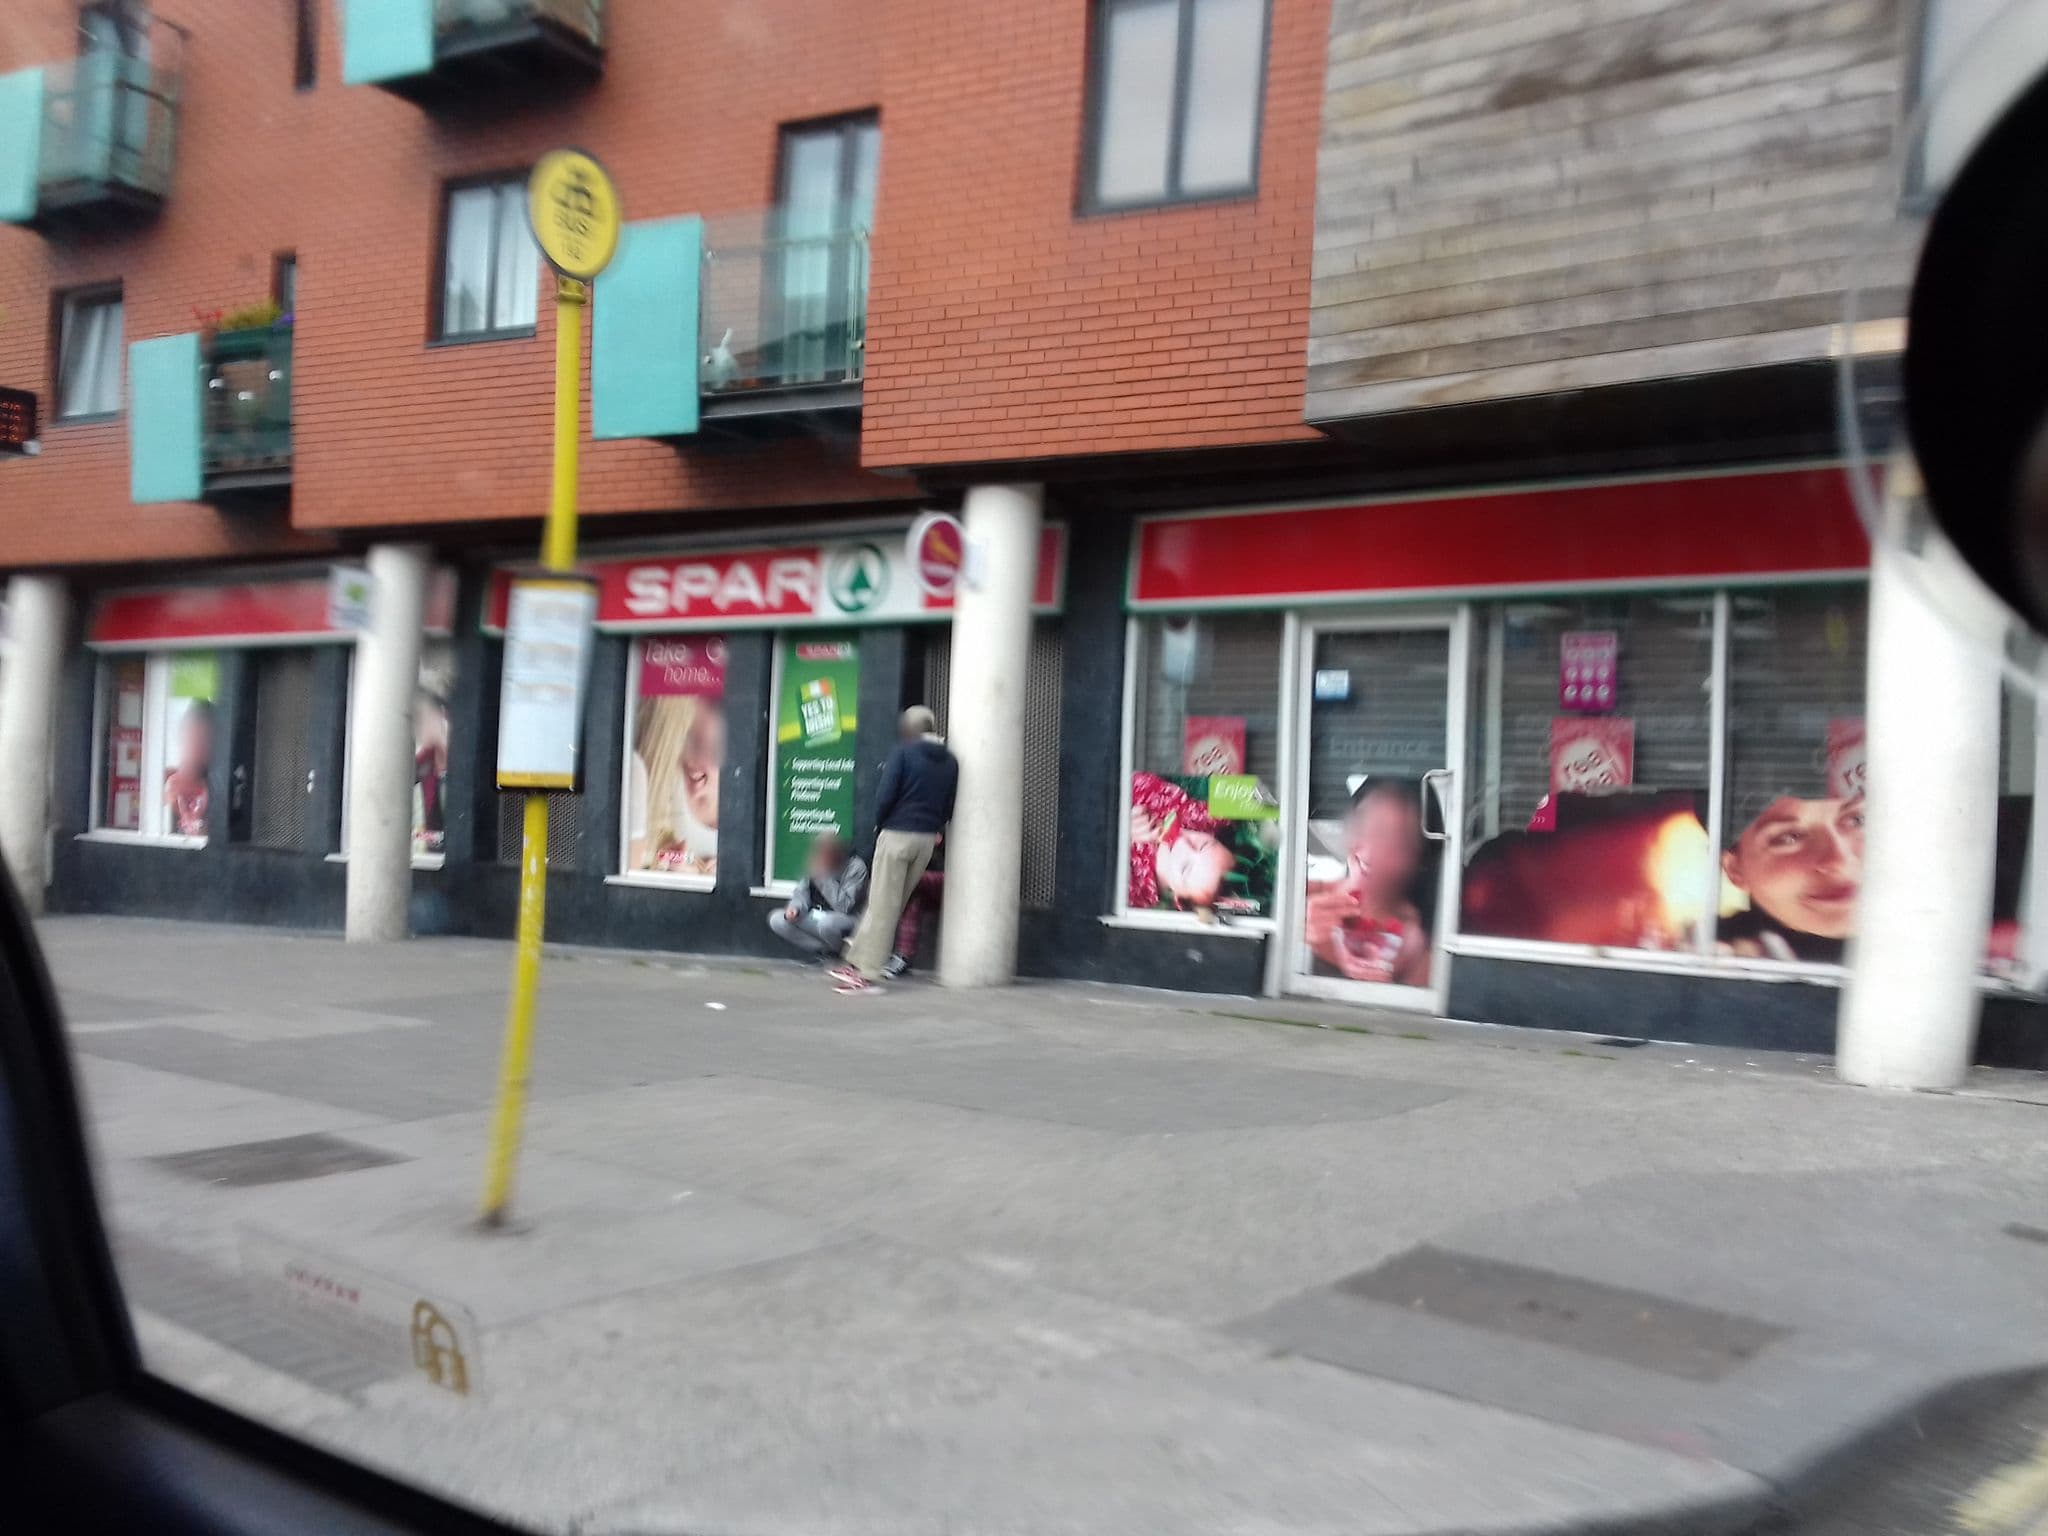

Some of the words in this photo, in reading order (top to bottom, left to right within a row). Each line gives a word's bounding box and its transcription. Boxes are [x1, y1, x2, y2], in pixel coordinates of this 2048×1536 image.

[624, 558, 816, 616] SPAR
[645, 638, 687, 663] Take
[801, 700, 821, 719] YES
[1214, 780, 1256, 802] Enjoy
